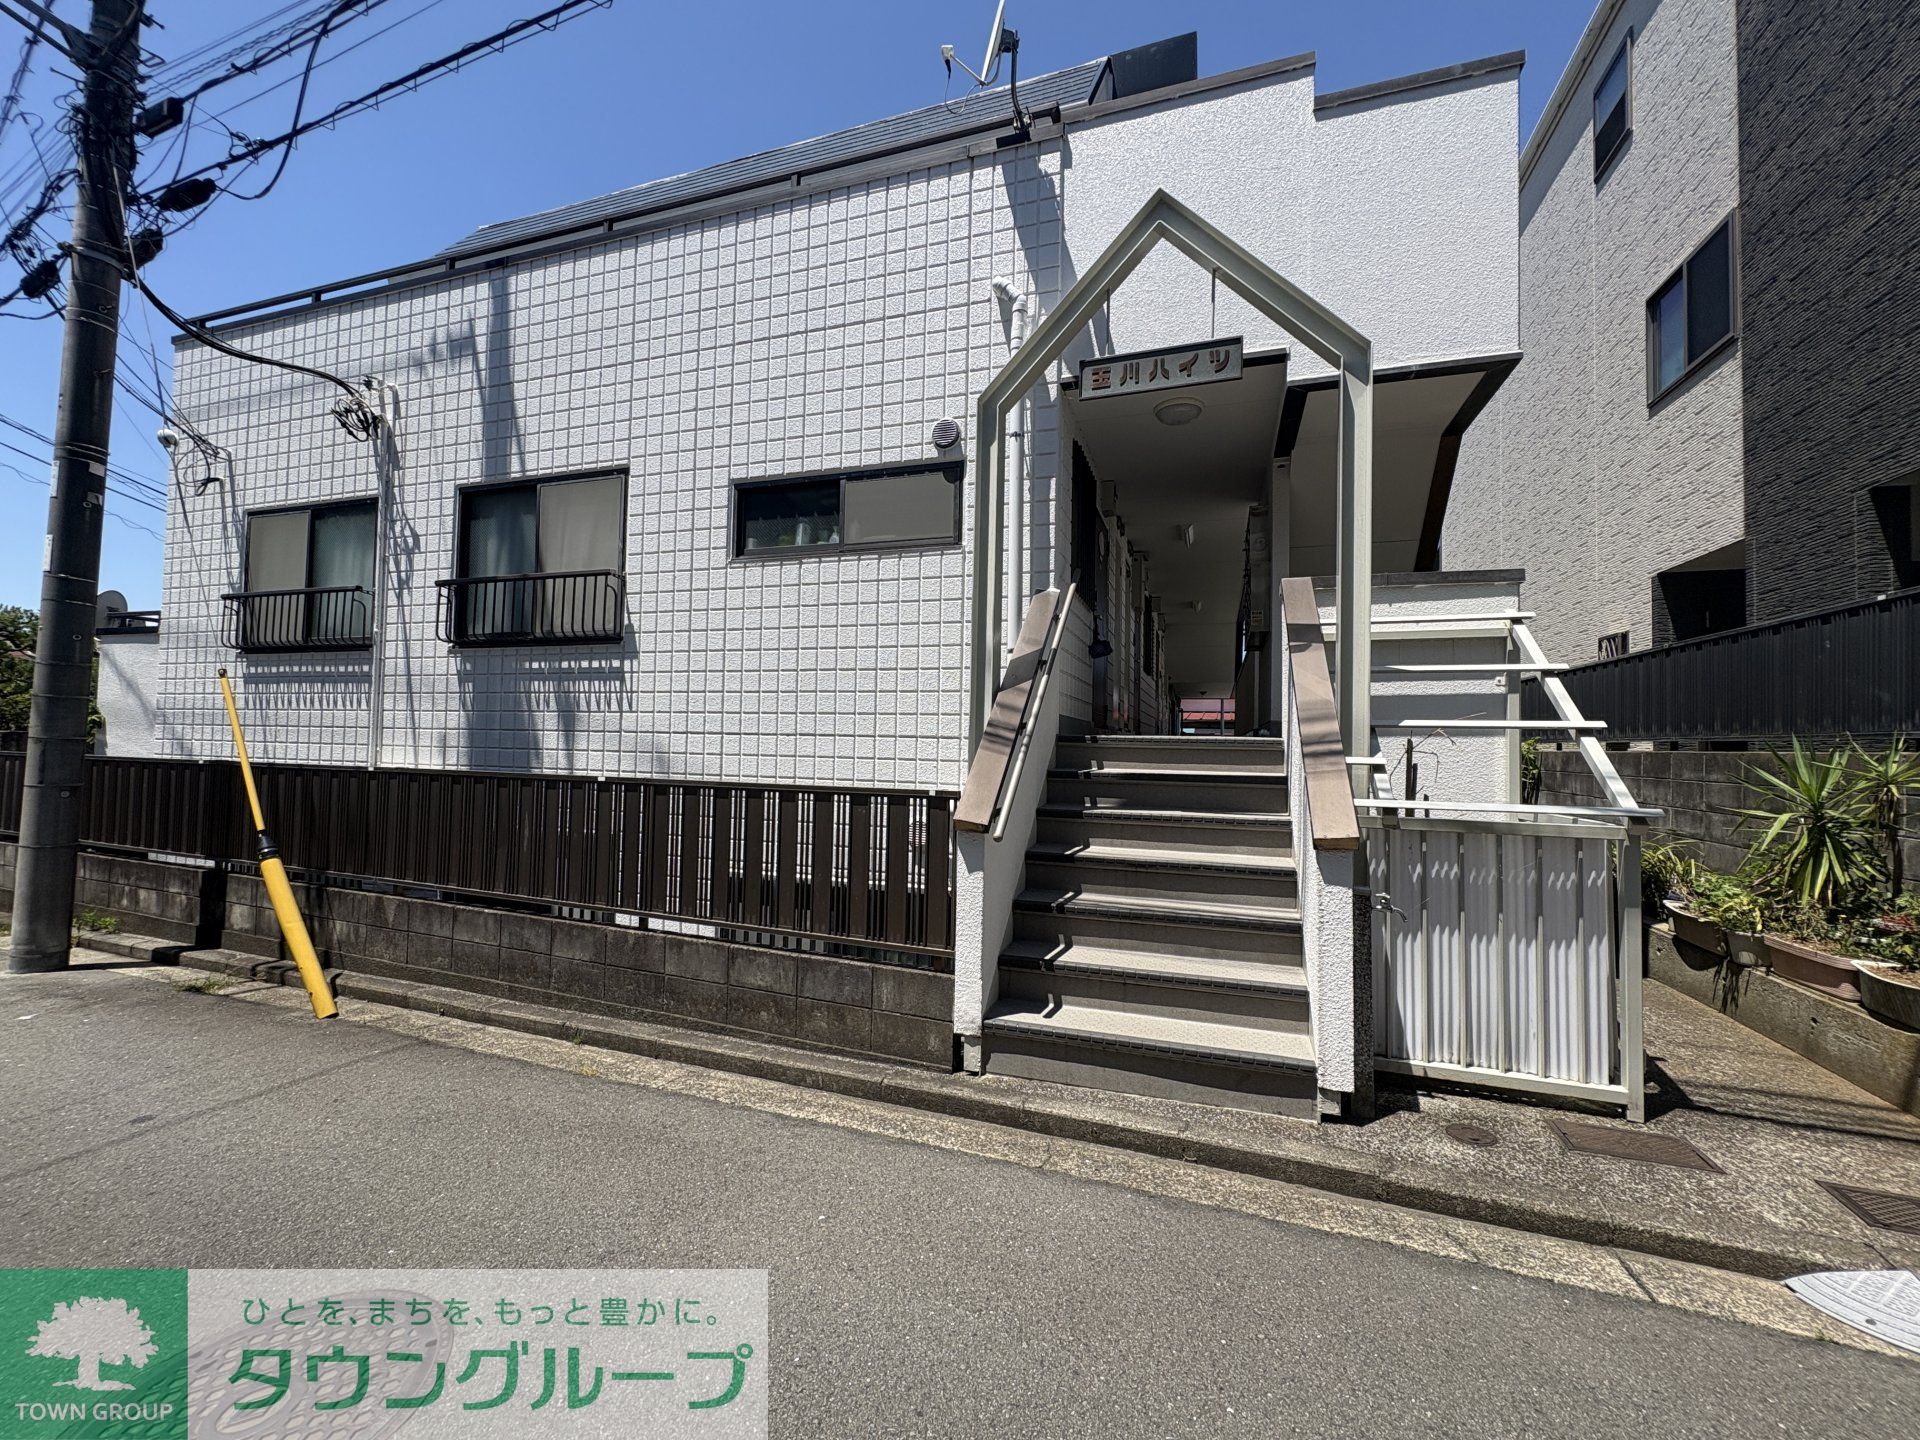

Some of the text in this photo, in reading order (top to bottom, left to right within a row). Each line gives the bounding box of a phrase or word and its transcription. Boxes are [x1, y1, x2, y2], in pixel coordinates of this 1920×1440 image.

[1091, 350, 1230, 390] 玉川ハイツ
